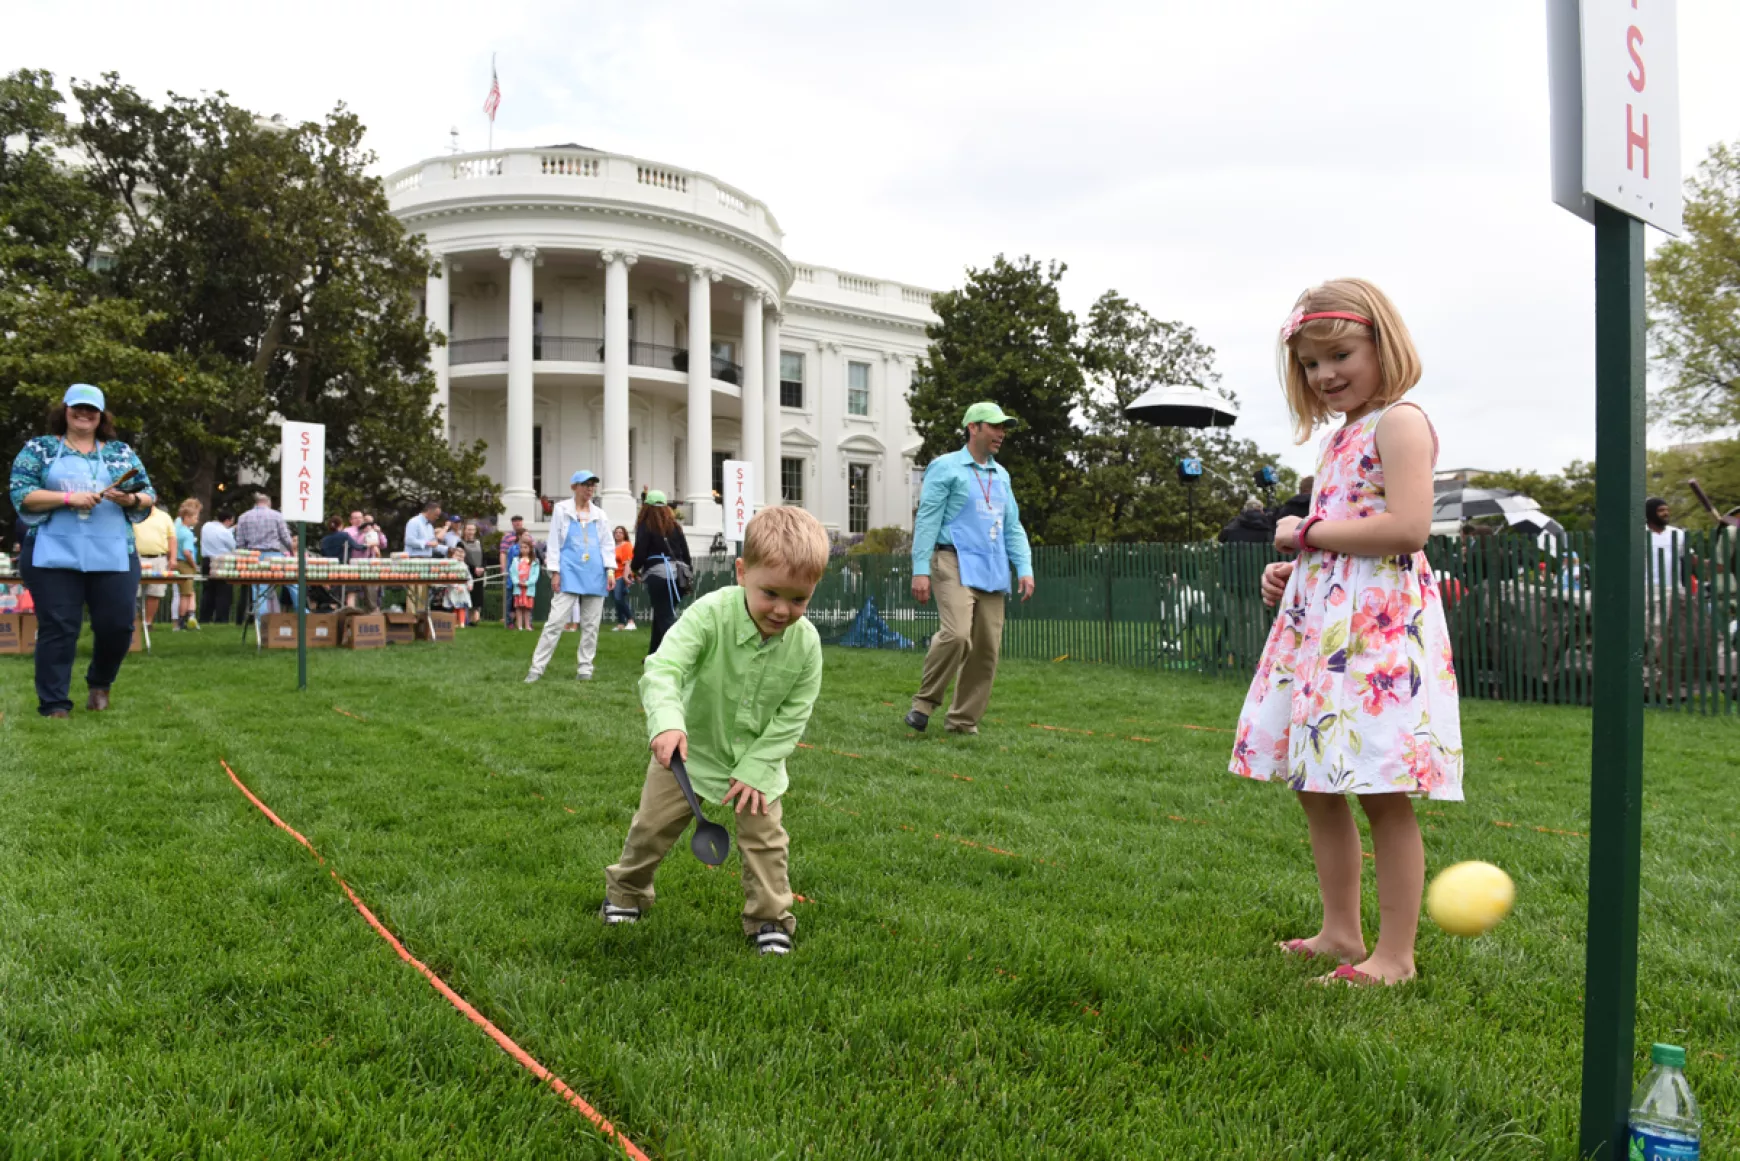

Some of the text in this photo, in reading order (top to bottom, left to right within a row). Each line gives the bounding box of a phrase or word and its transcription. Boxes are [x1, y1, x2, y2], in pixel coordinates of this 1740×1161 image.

[1626, 0, 1650, 180] SH
[299, 431, 311, 512] START
[735, 467, 745, 533] START
